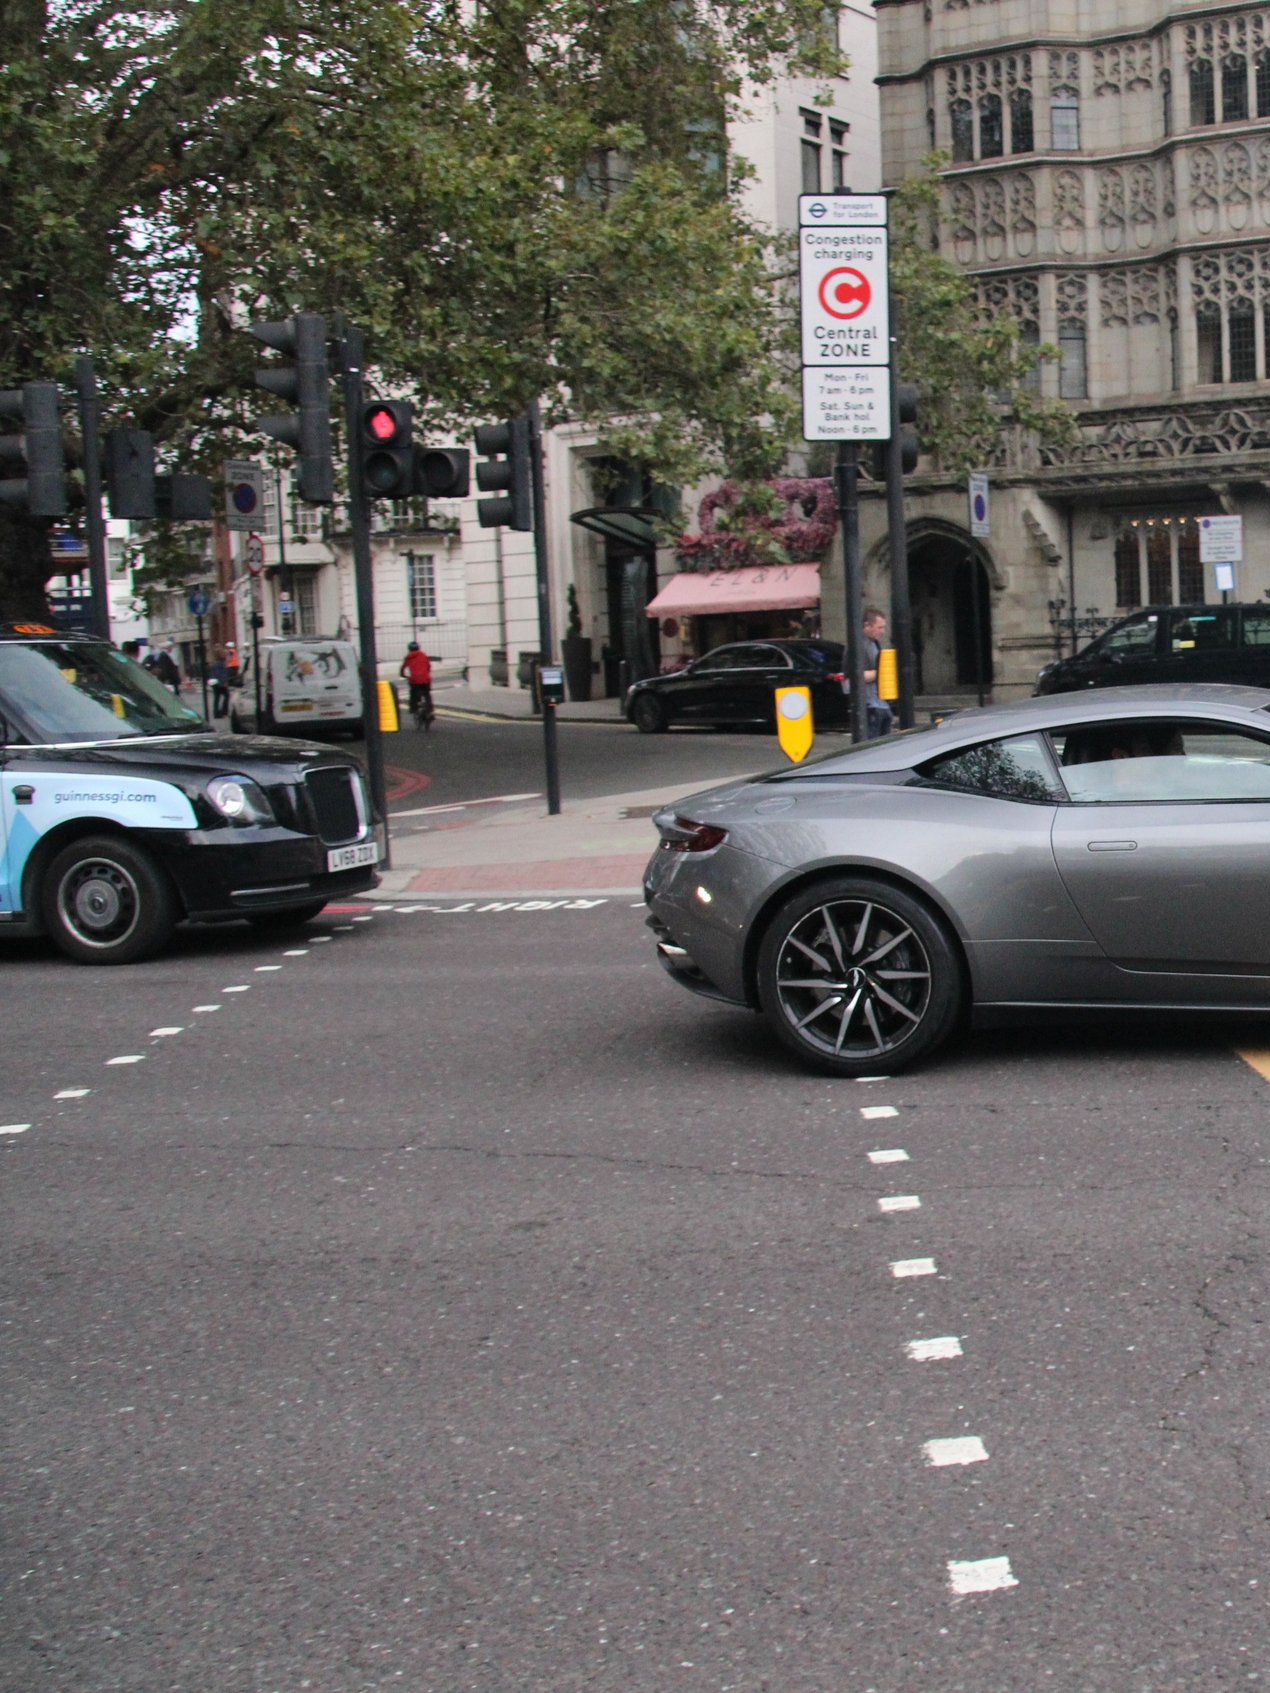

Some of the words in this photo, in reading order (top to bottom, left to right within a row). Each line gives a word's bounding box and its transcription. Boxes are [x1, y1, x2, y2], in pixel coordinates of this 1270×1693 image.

[833, 202, 873, 210] Transport
[805, 233, 883, 246] Congestion
[814, 248, 873, 261] charging
[814, 326, 878, 339] Central
[820, 343, 870, 357] ZONE
[825, 373, 847, 381] Mon
[855, 373, 869, 381] Fri
[844, 402, 864, 410] Sun
[867, 402, 874, 410] &
[825, 413, 850, 421] Bank
[854, 413, 870, 421] hol
[817, 426, 845, 434] Noon
[249, 546, 261, 563] 20
[54, 790, 157, 804] guinnessgi.com
